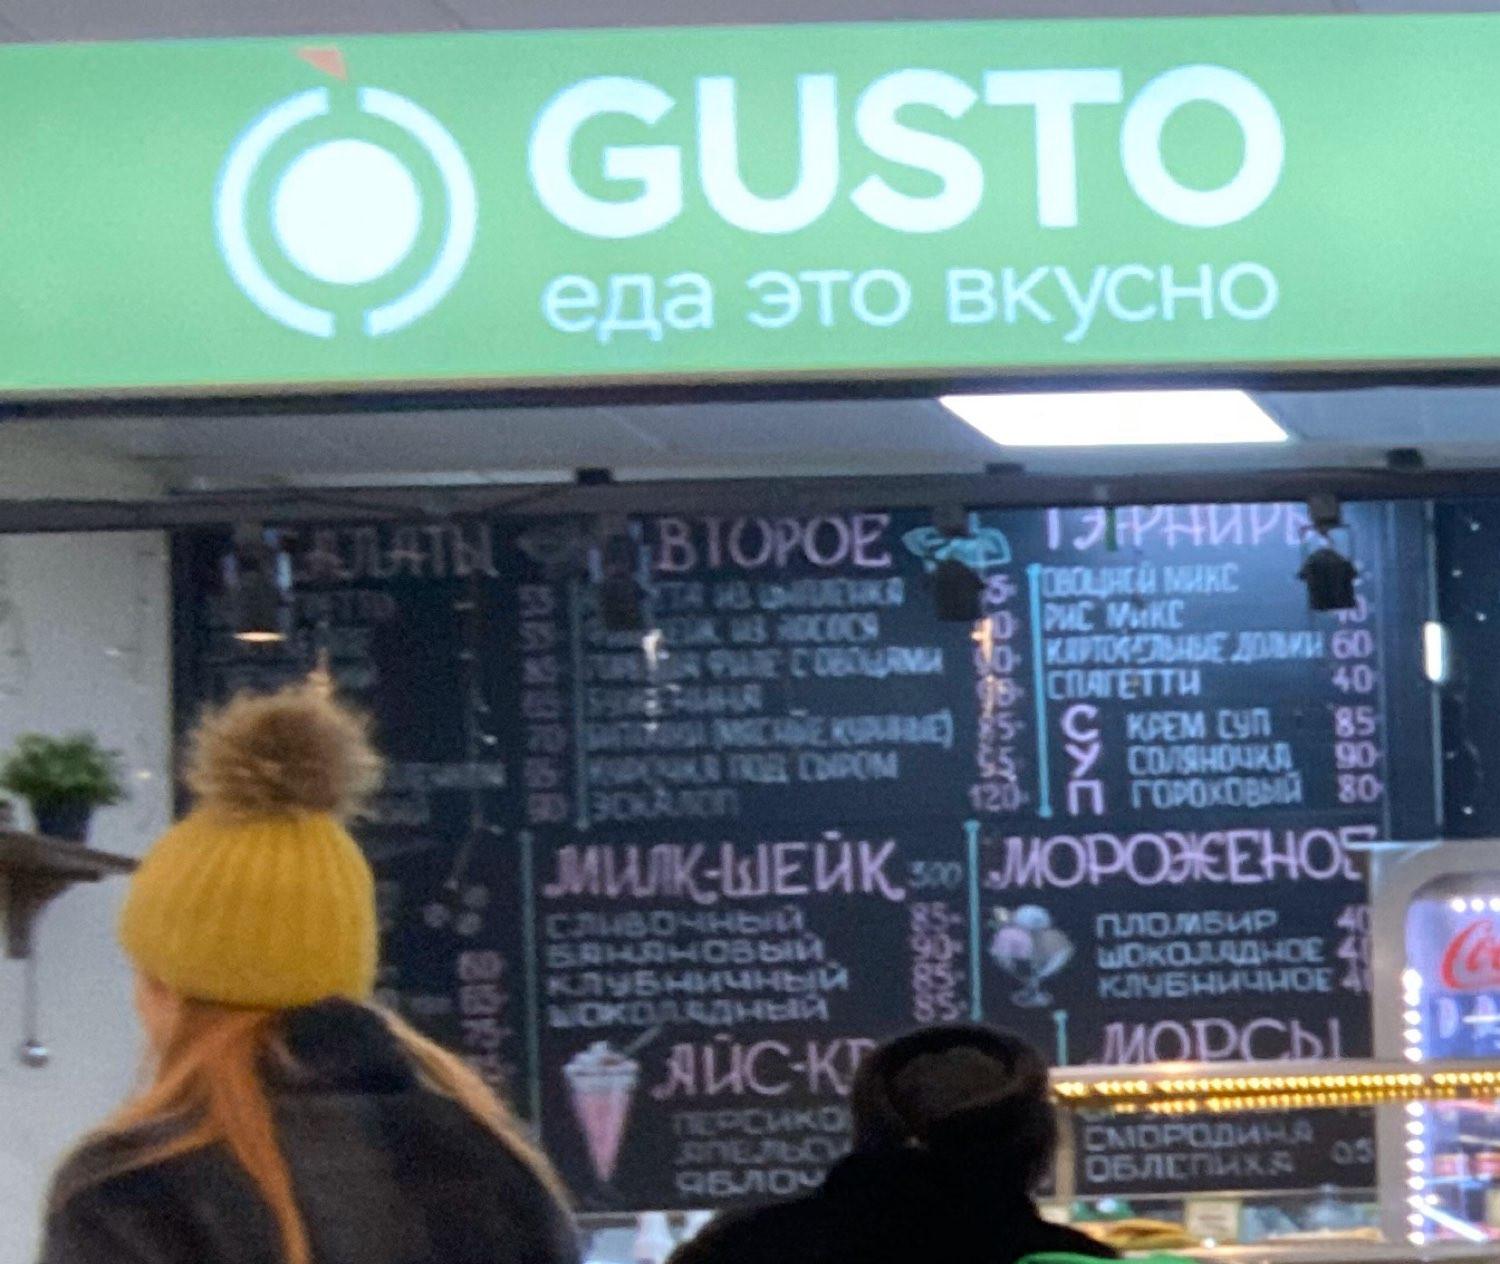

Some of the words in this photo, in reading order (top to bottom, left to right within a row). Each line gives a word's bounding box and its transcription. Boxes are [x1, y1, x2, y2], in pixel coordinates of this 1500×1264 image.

[527, 62, 1286, 239] GUSTO
[541, 271, 716, 343] еда
[746, 269, 913, 328] это
[945, 259, 1280, 344] вкусно
[656, 513, 893, 573] ВТОРОЕ
[1045, 601, 1094, 631] РИС
[1105, 598, 1184, 629] МИКС
[1046, 667, 1201, 700] СПАГЕТТИ
[1126, 709, 1205, 742] КРЕМ
[1217, 707, 1272, 739] СУП
[1130, 771, 1302, 810] ГОРОХОВЫЙ
[541, 829, 907, 905] МИЛК-ШЕЙК
[988, 825, 1378, 890] МОРОЖЕНОЕ
[1096, 909, 1278, 939] ПЛОМБИР
[547, 960, 849, 998] КЛУБНИЧНЫЙ
[1097, 966, 1334, 998] КЛУБНИЧНОЕ
[1087, 1017, 1342, 1066] МОРСЫ
[674, 1107, 853, 1136] ПЕРСИКО
[1082, 1118, 1316, 1152] СМОРОДИНА
[675, 1168, 827, 1195] ЯБЛОЧ
